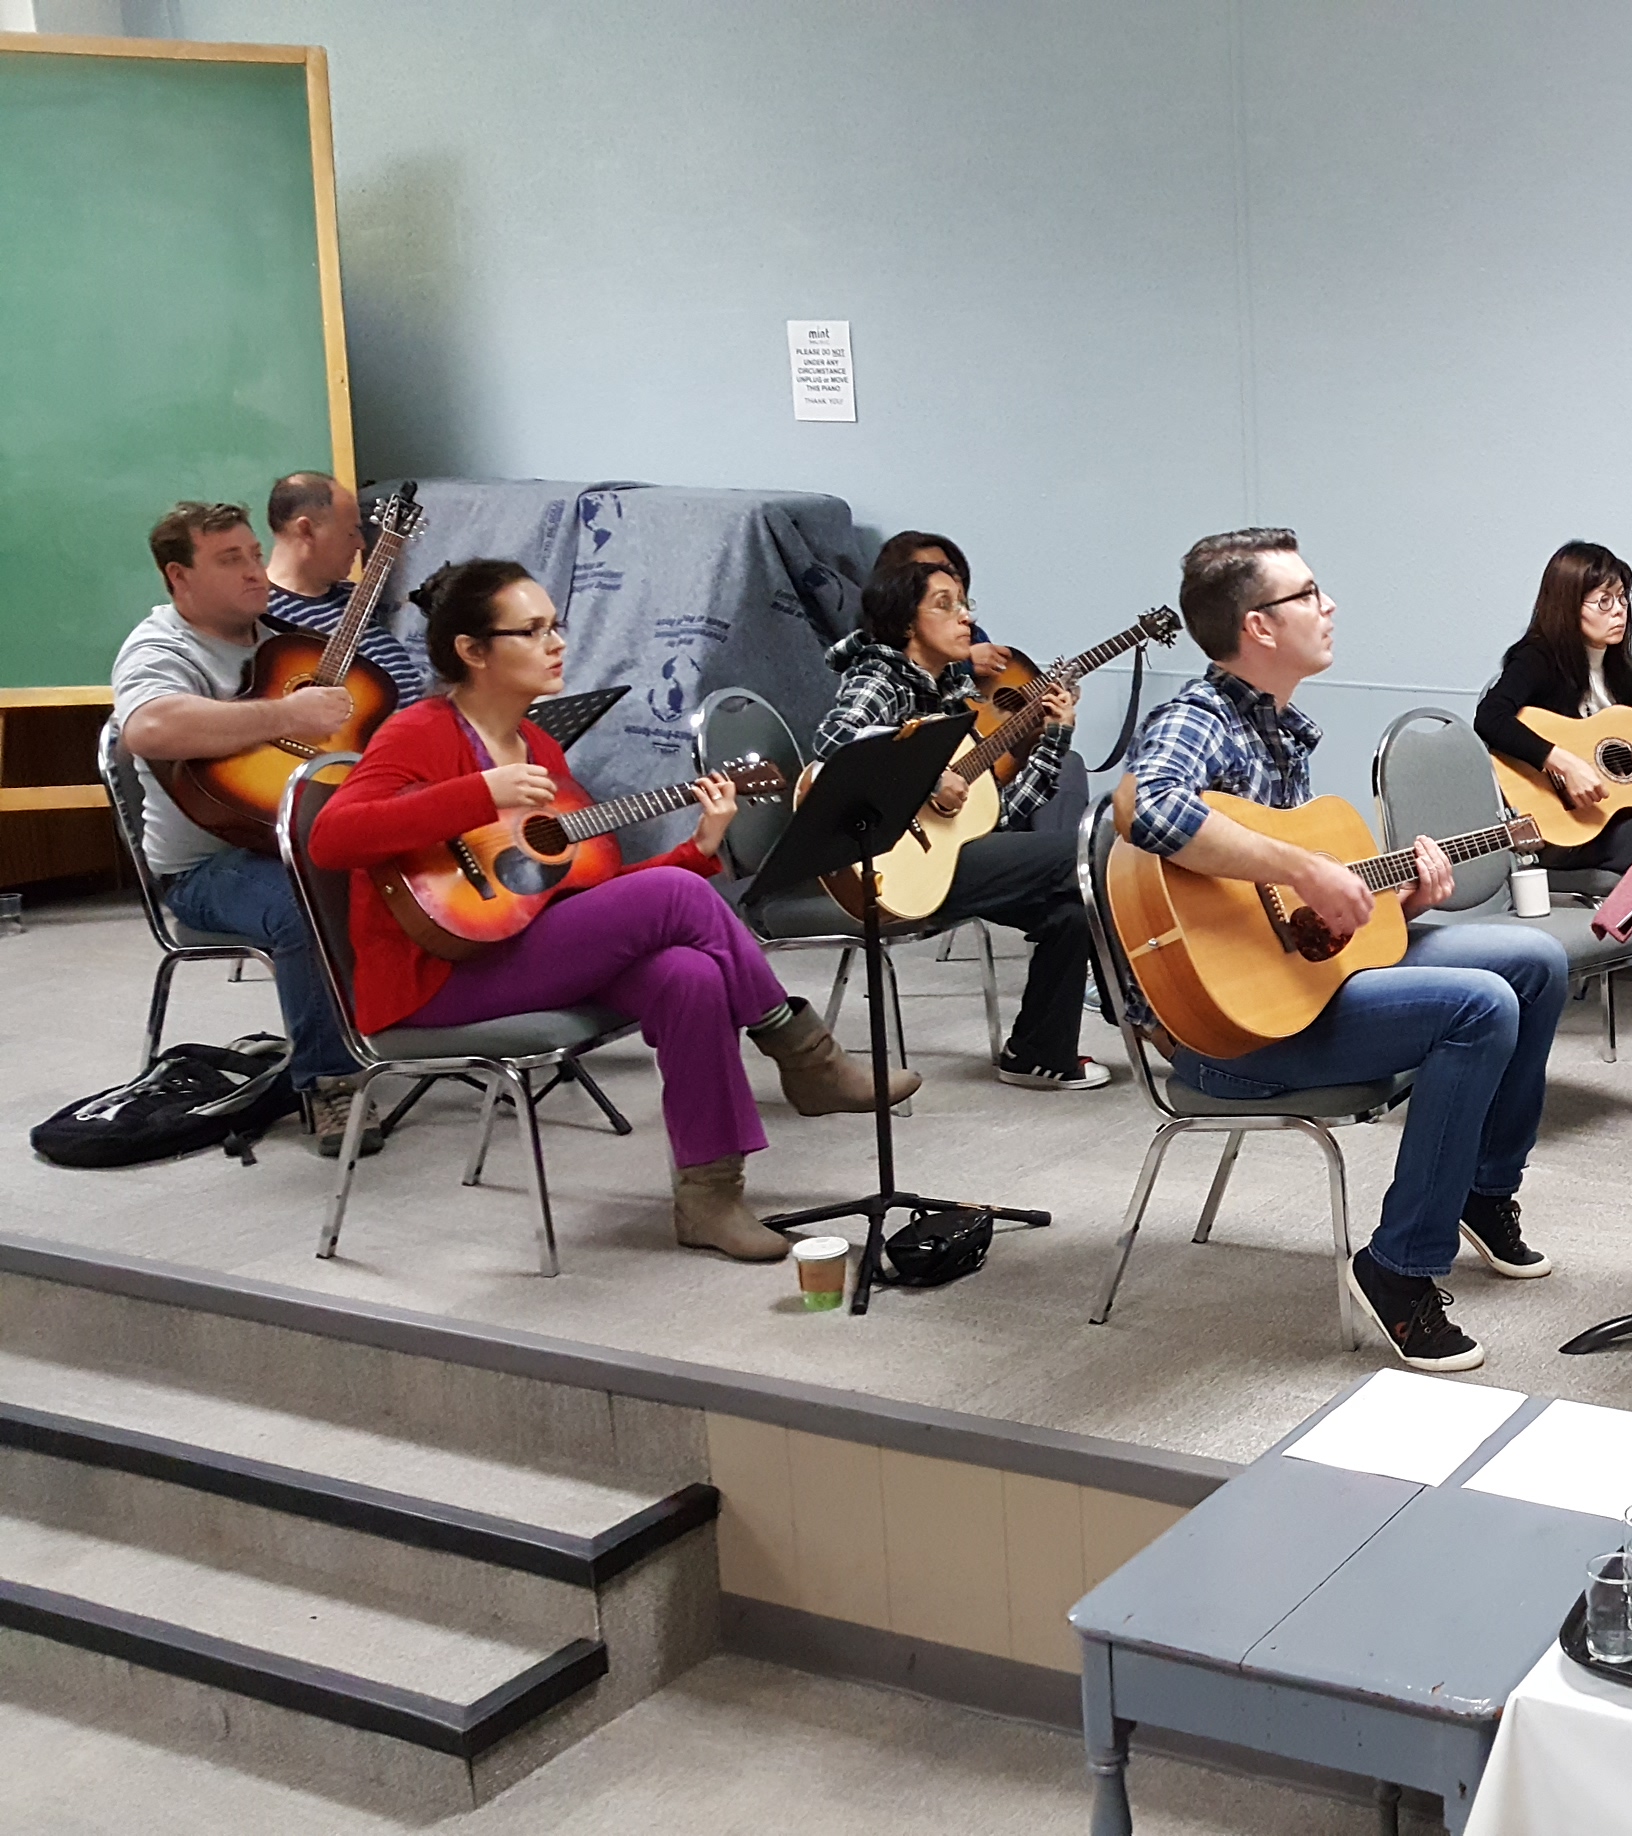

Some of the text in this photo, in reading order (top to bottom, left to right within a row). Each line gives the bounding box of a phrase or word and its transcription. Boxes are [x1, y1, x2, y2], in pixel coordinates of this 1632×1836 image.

[808, 327, 831, 339] mint
[796, 348, 845, 357] PLEASE DO NOT
[797, 367, 846, 375] CIRCUMSTANCE
[830, 376, 849, 384] MOVE
[821, 384, 841, 392] PIANO
